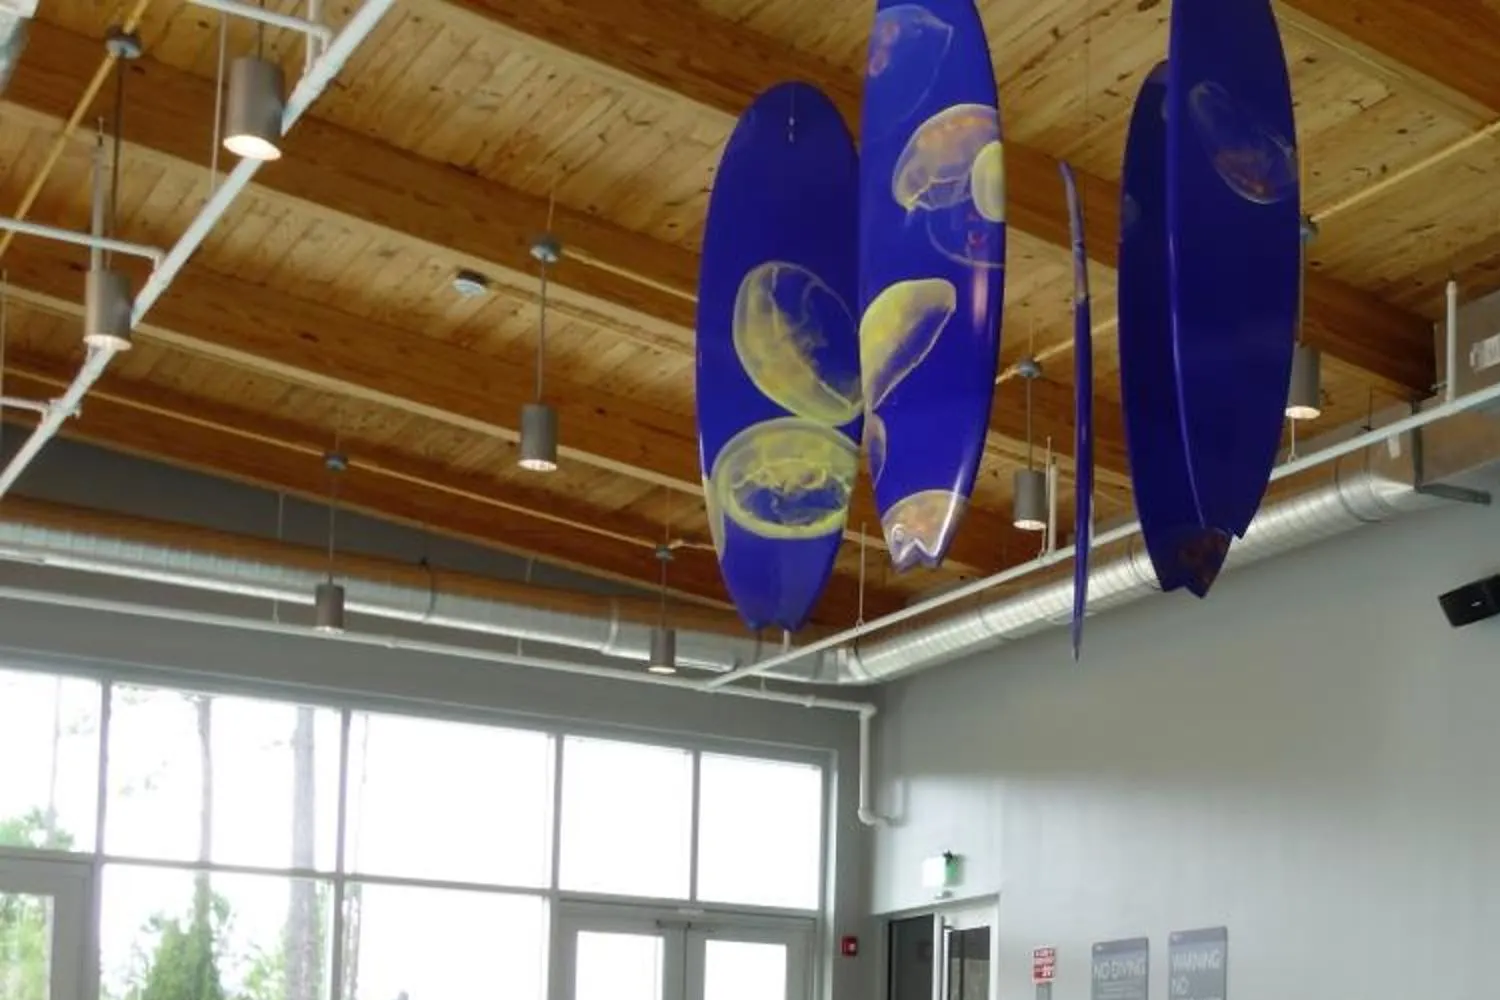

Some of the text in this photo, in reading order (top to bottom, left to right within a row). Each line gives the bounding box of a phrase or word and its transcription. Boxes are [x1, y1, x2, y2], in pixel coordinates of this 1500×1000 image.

[1093, 961, 1109, 980] NO
[1171, 948, 1222, 972] WARNING
[1171, 975, 1190, 996] NO
